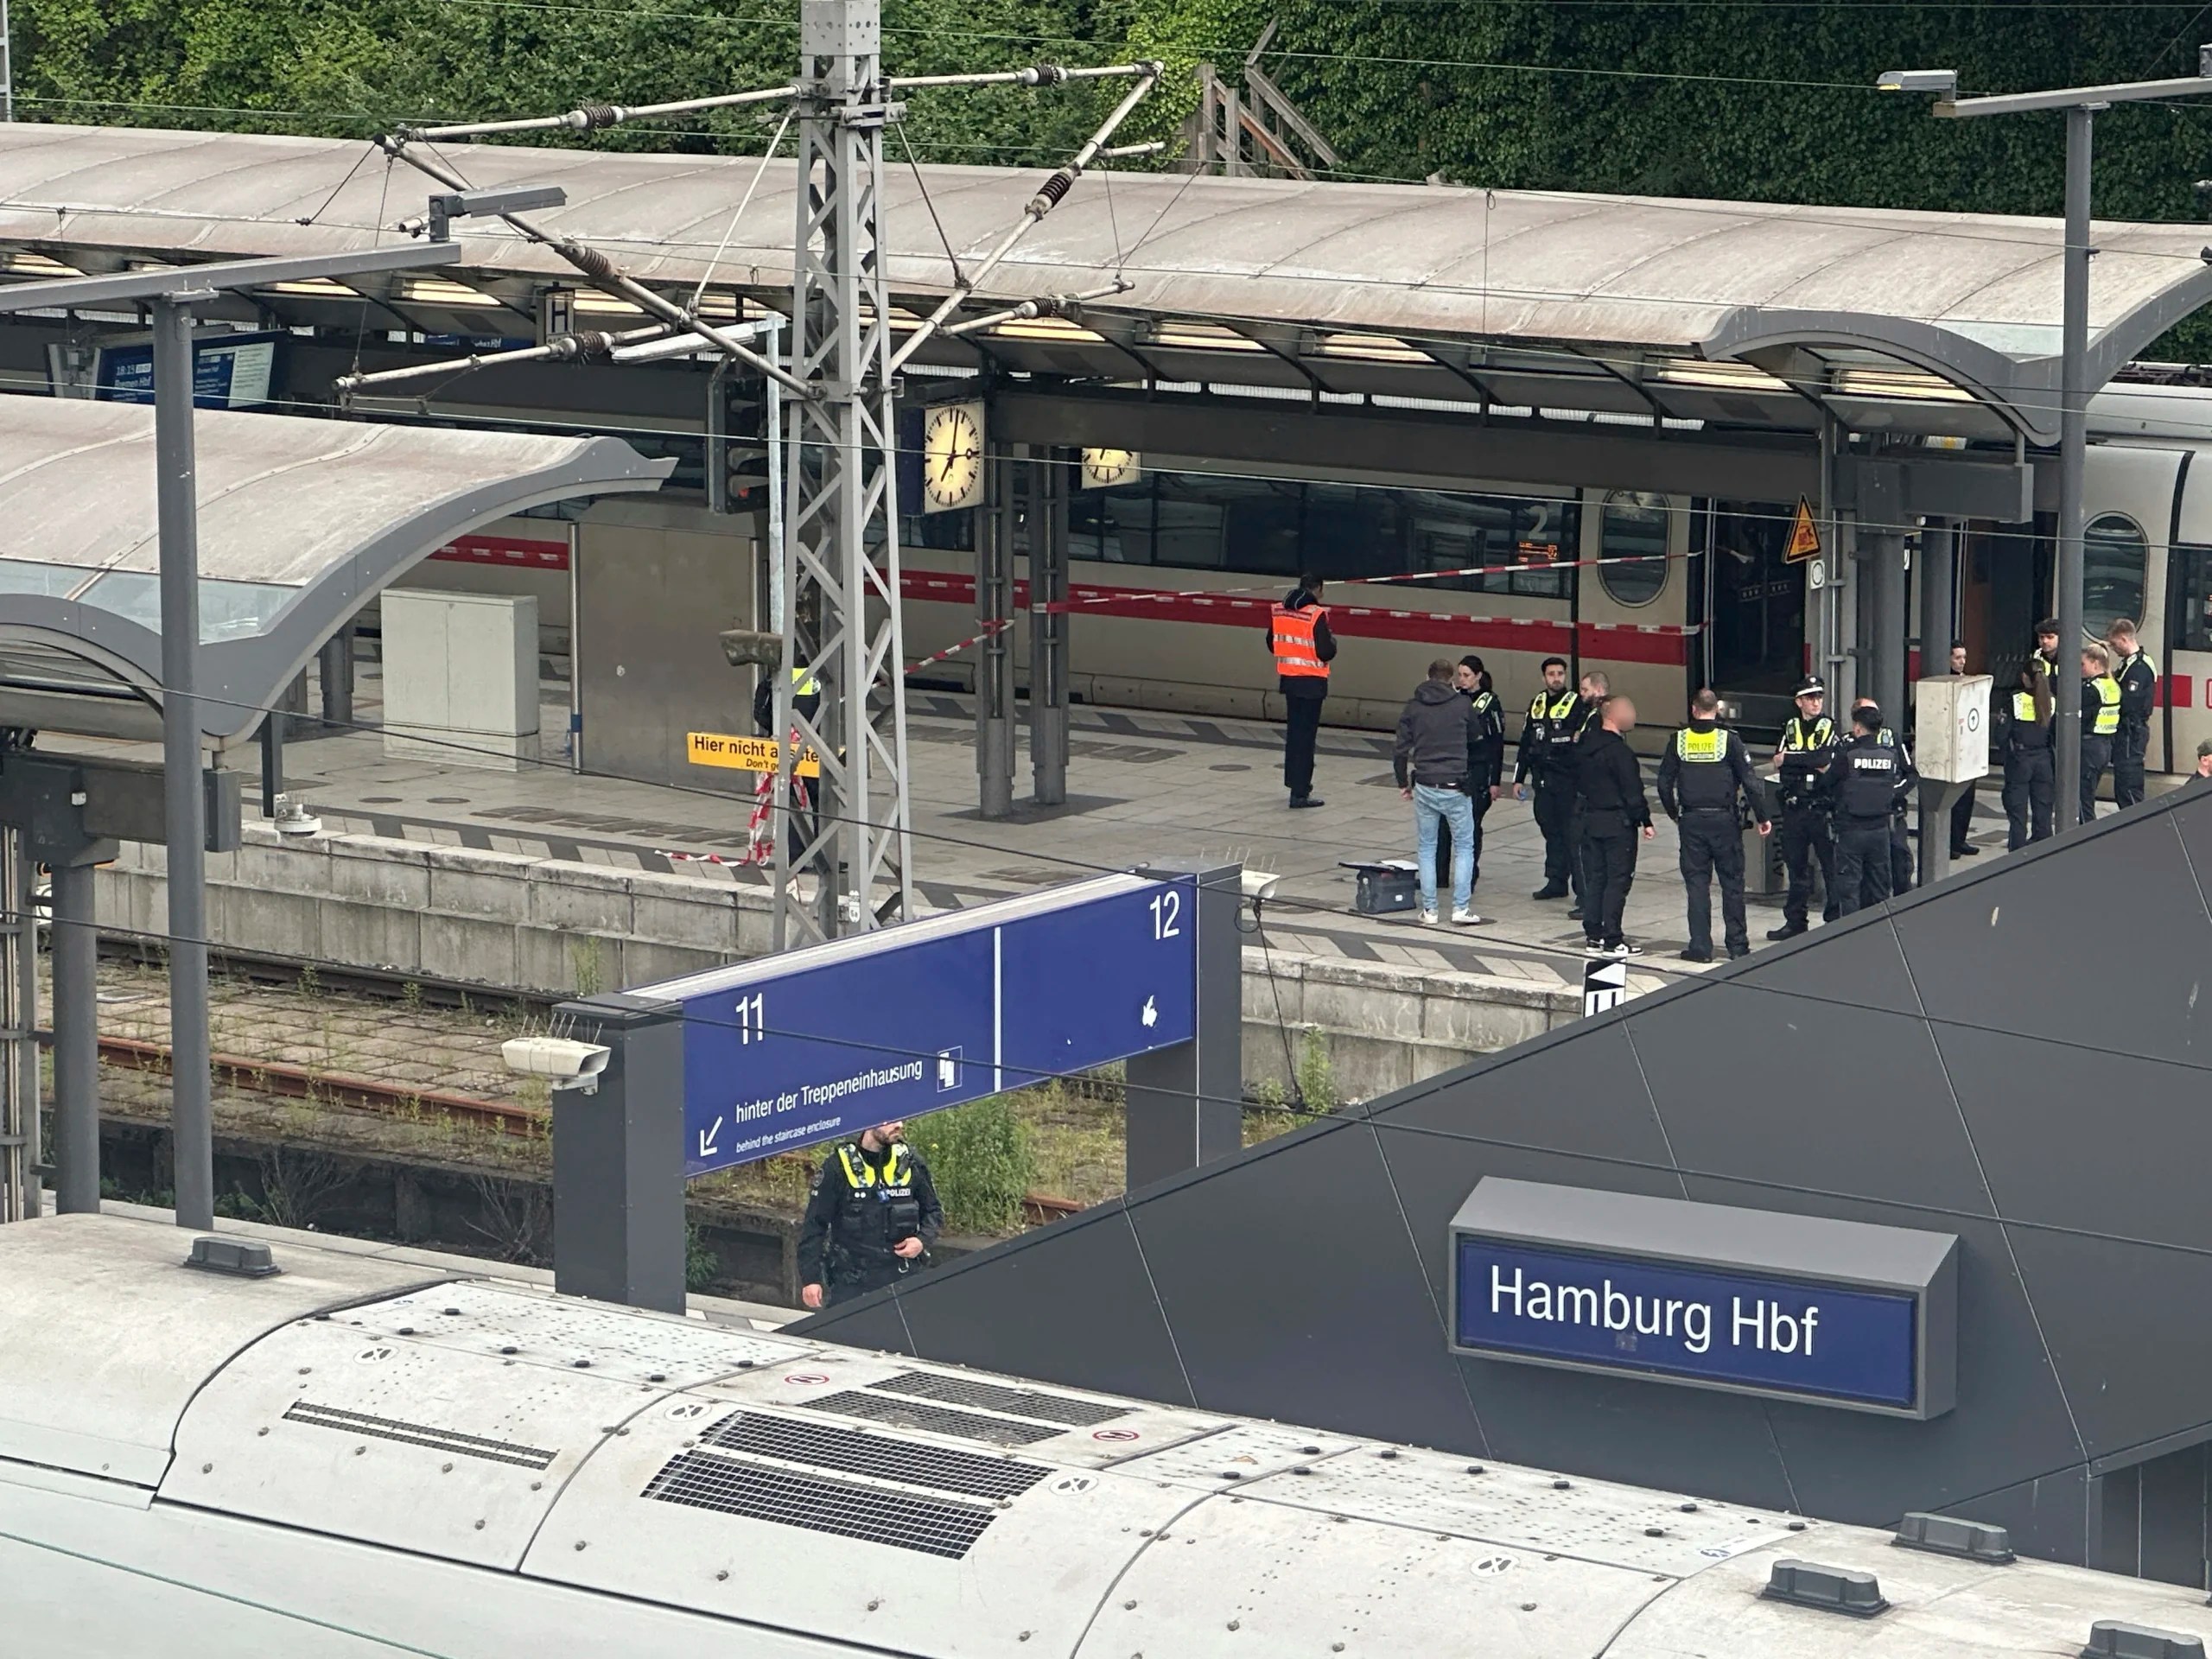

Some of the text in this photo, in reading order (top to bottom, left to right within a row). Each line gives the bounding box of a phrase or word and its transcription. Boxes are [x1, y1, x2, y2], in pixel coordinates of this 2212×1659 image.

[1523, 505, 1548, 539] 2
[694, 735, 724, 753] Hier
[728, 740, 766, 757] nicht
[746, 758, 769, 769] Don't
[1688, 742, 1715, 752] POLIZEI
[1853, 758, 1891, 770] POLIZEI
[1149, 890, 1180, 940] 12
[735, 993, 763, 1045] 11
[736, 1060, 923, 1124] hinter der Treppeneinhausung
[736, 1116, 842, 1154] behind the staircase enclosure
[1491, 1264, 1819, 1357] Hamburg Hbf
